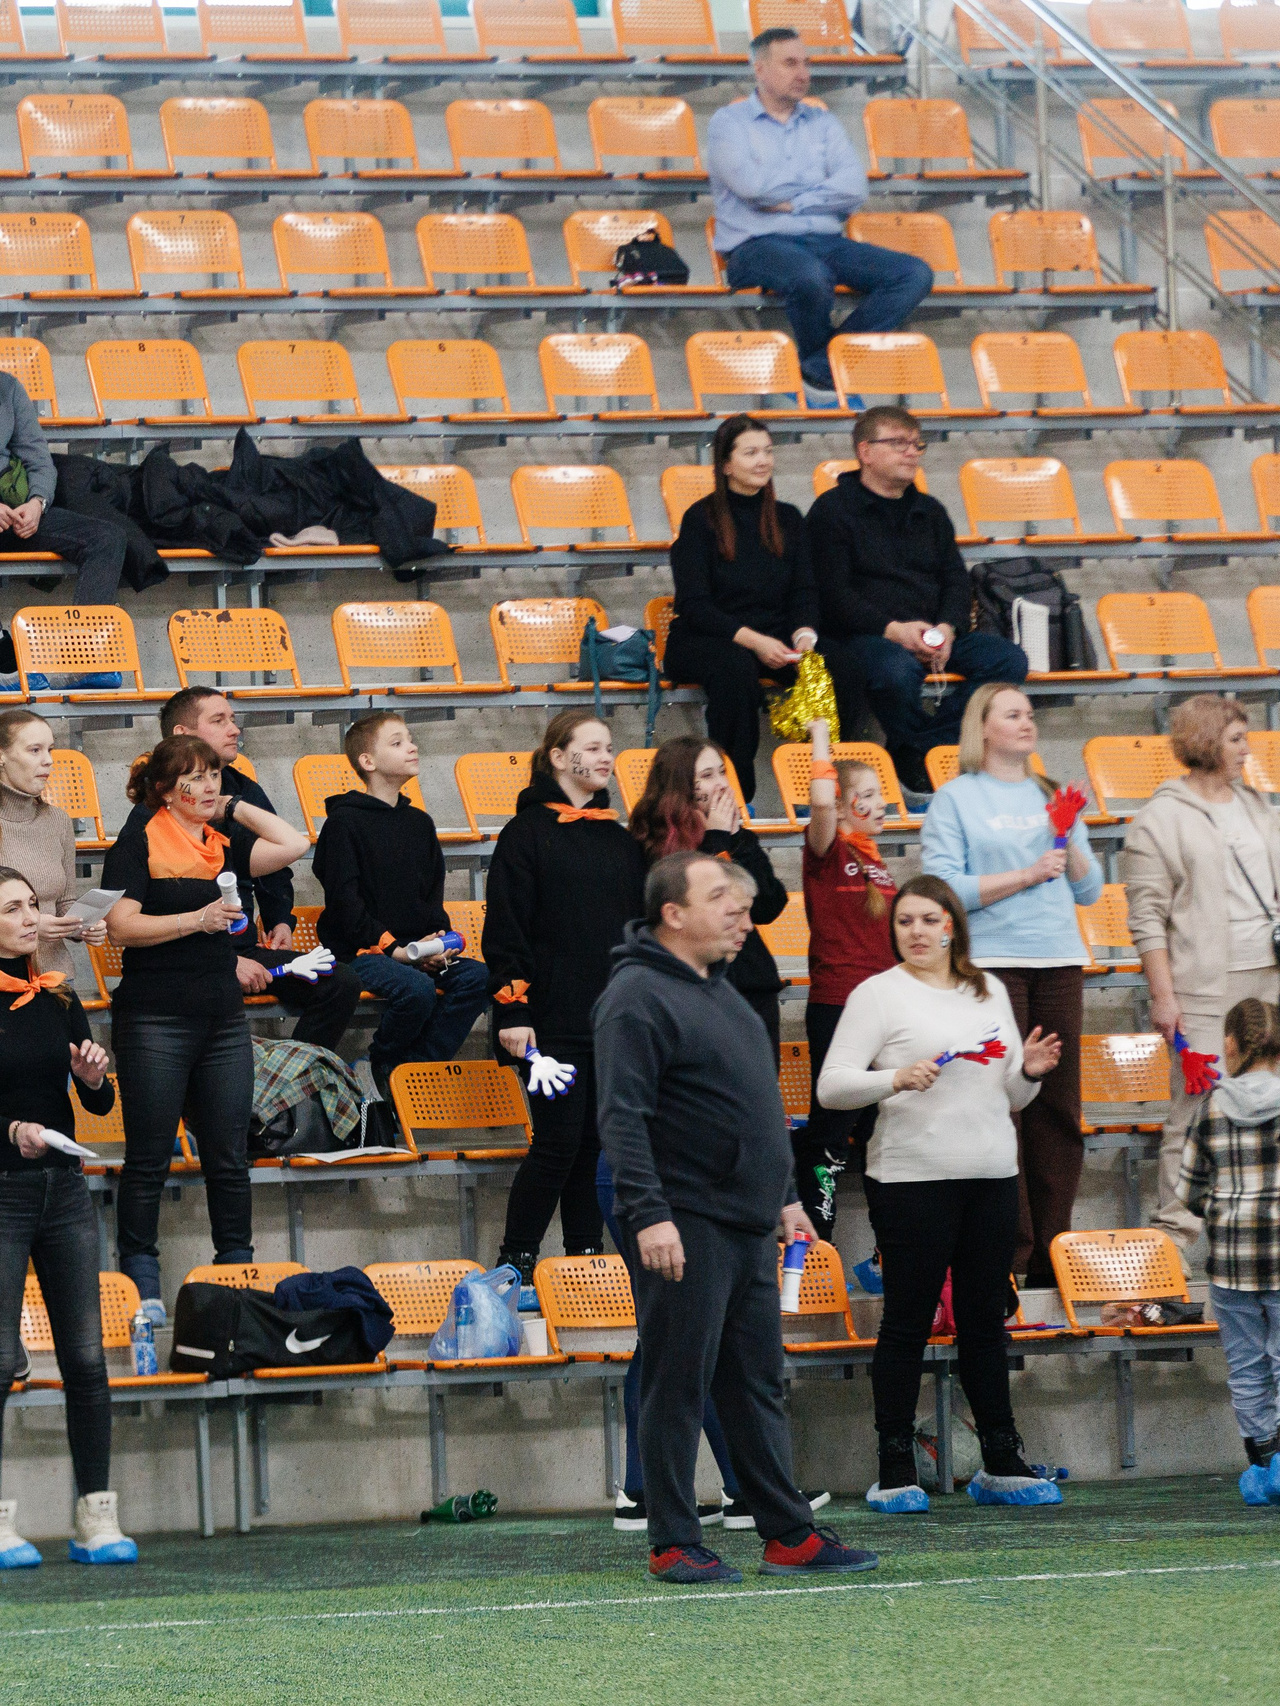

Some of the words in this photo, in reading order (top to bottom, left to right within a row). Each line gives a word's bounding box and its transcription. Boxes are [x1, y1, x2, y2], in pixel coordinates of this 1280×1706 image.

[66, 99, 74, 108] 7
[29, 216, 37, 226] 8
[179, 214, 186, 224] 7
[138, 342, 146, 352] 8
[288, 344, 297, 353] 7
[438, 343, 446, 352] 6
[386, 606, 394, 617] 8
[544, 601, 552, 612] 7
[64, 609, 81, 620] 10
[509, 755, 518, 765] 8
[792, 1046, 801, 1057] 8
[444, 1065, 462, 1076] 10
[1108, 1233, 1116, 1244] 7
[589, 1258, 607, 1270] 10
[241, 1269, 259, 1281] 12
[415, 1265, 431, 1275] 11
